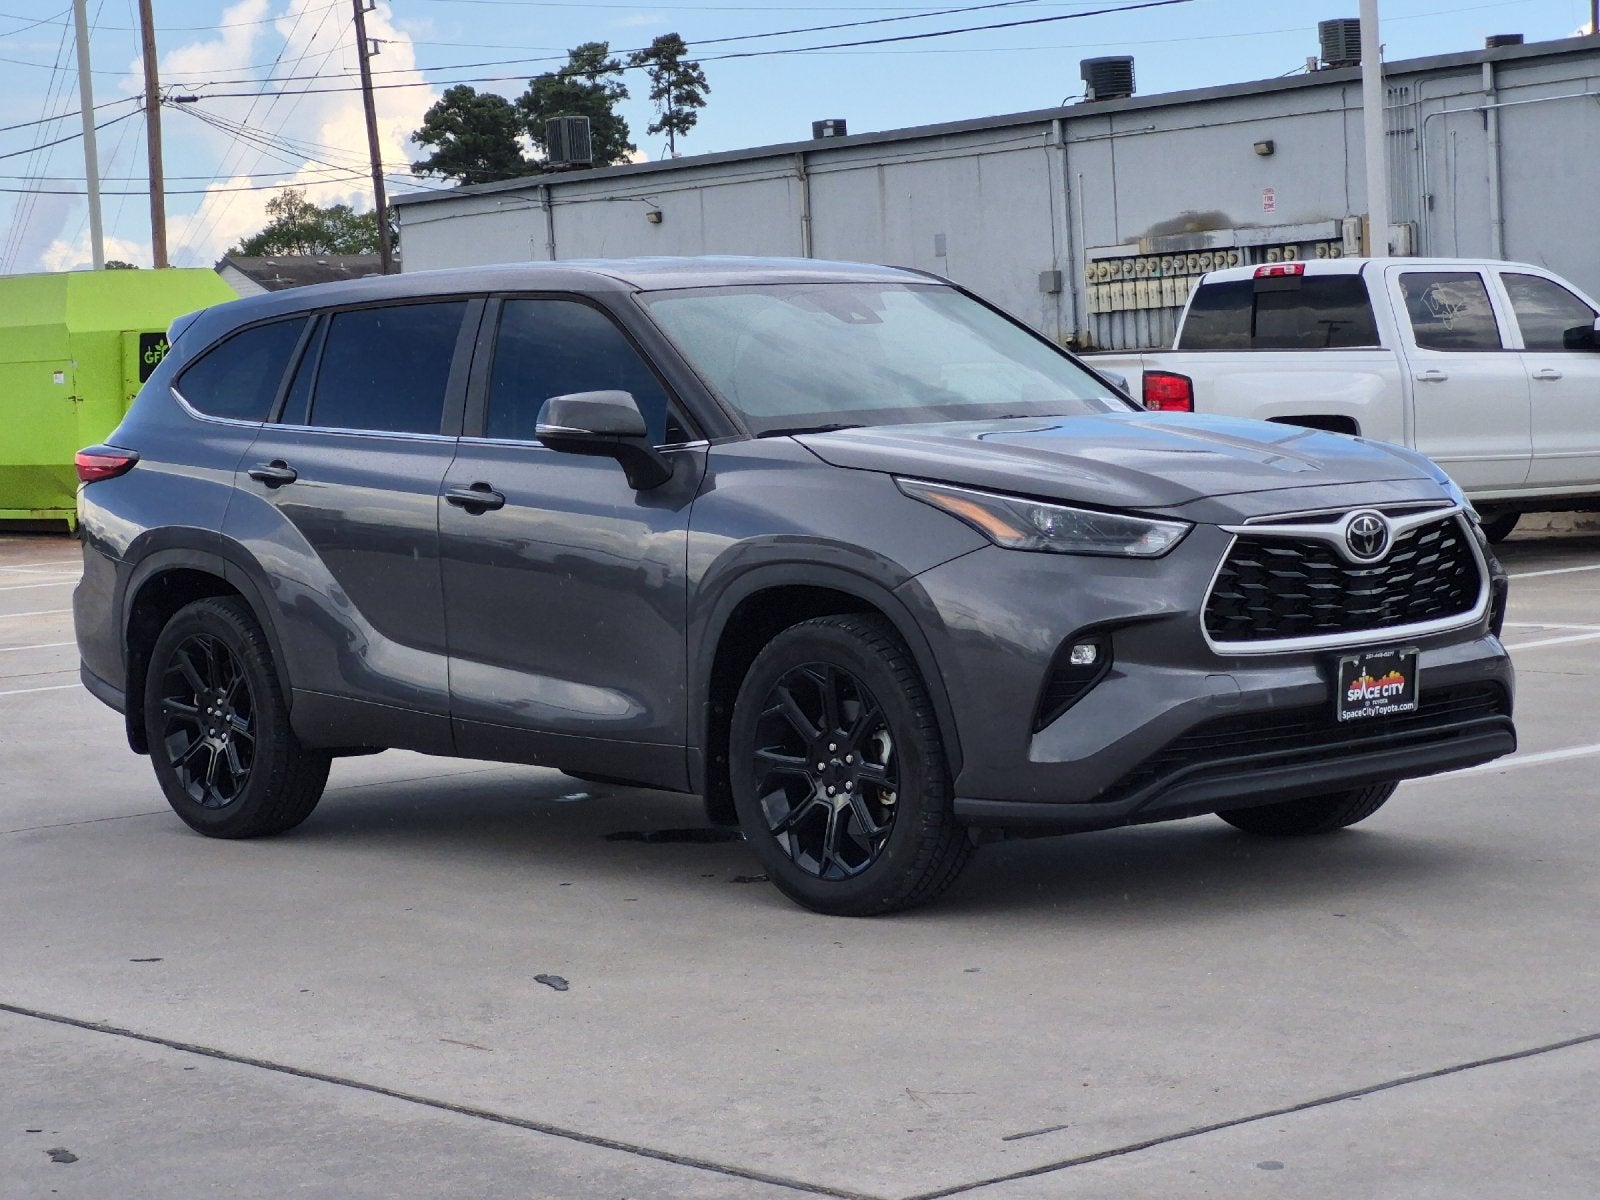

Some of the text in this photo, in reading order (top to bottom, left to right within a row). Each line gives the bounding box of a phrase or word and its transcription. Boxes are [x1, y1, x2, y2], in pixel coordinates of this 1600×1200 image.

[1347, 682, 1404, 701] SPACE CITY
[1342, 703, 1414, 720] SpaceCityToyota.com
